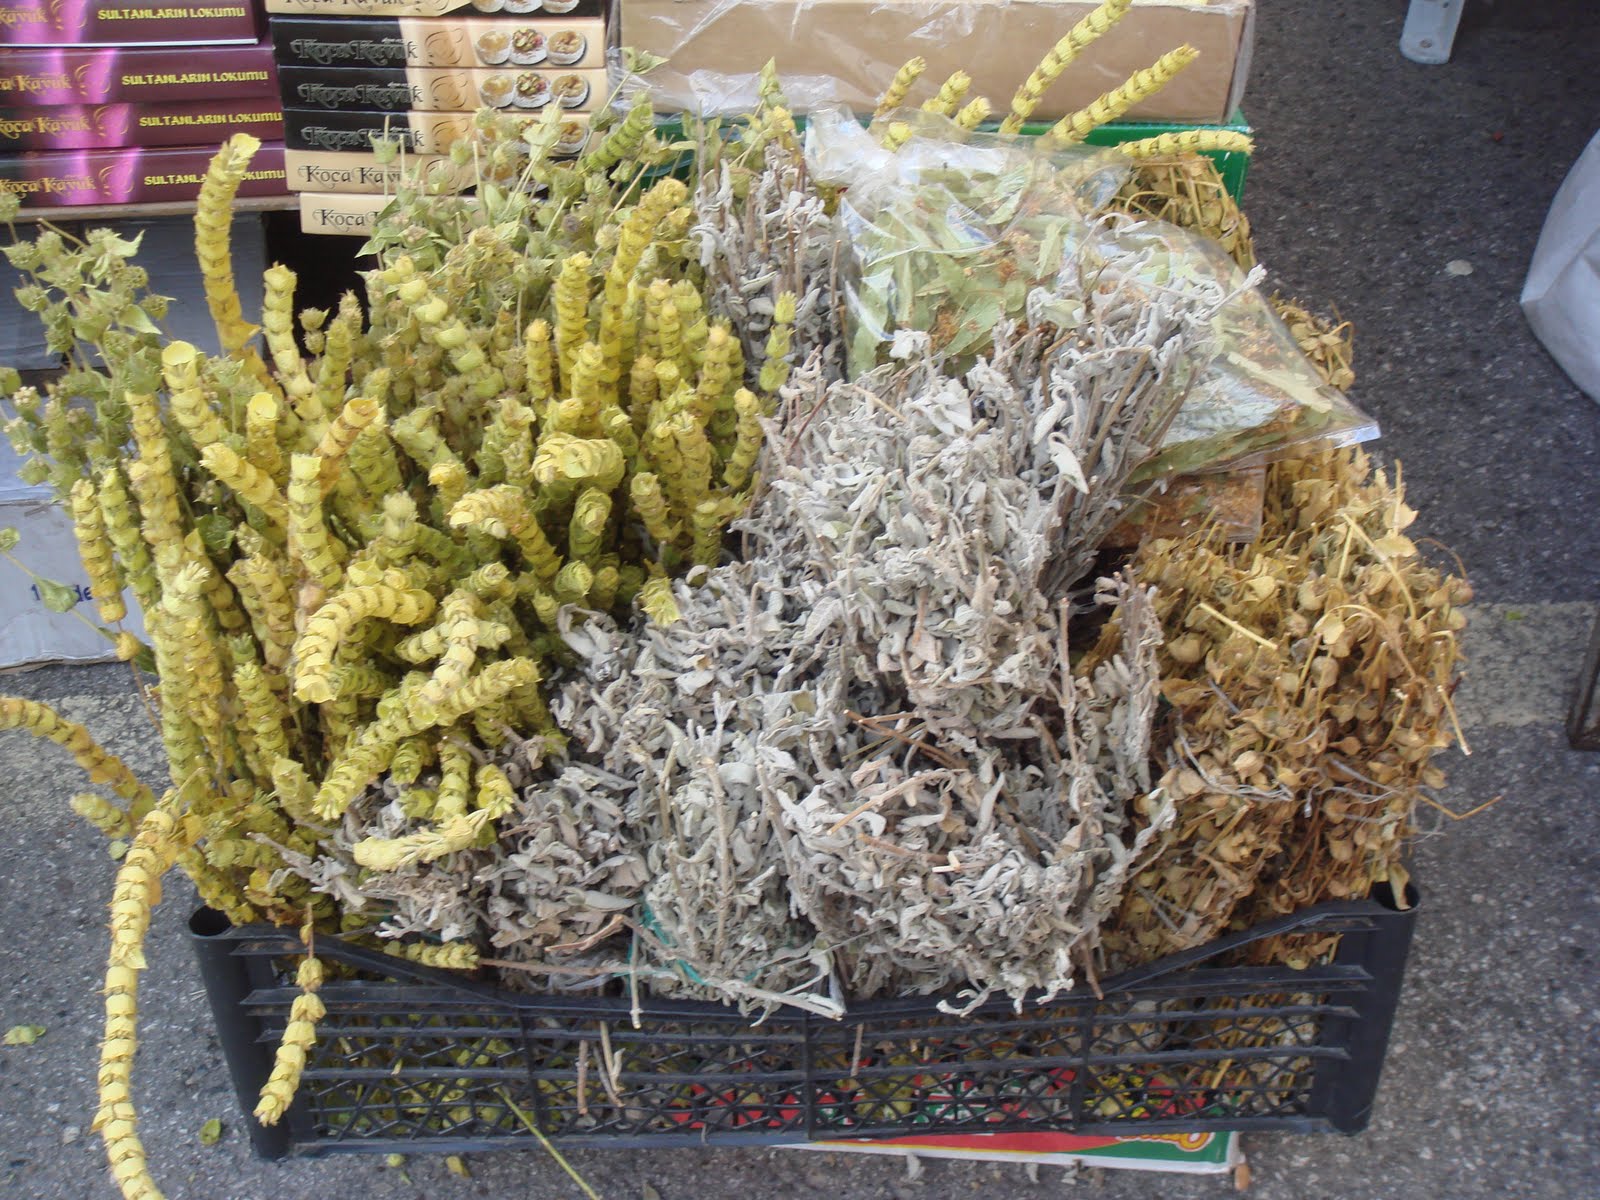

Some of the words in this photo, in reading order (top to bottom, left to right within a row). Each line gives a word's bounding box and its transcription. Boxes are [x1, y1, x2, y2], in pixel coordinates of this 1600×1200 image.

[97, 8, 188, 20] SULTANLARIN
[121, 73, 211, 86] SULTANLARIN
[139, 114, 227, 127] SULTANLARIN
[240, 170, 285, 181] OKUMU
[312, 209, 364, 232] Koca
